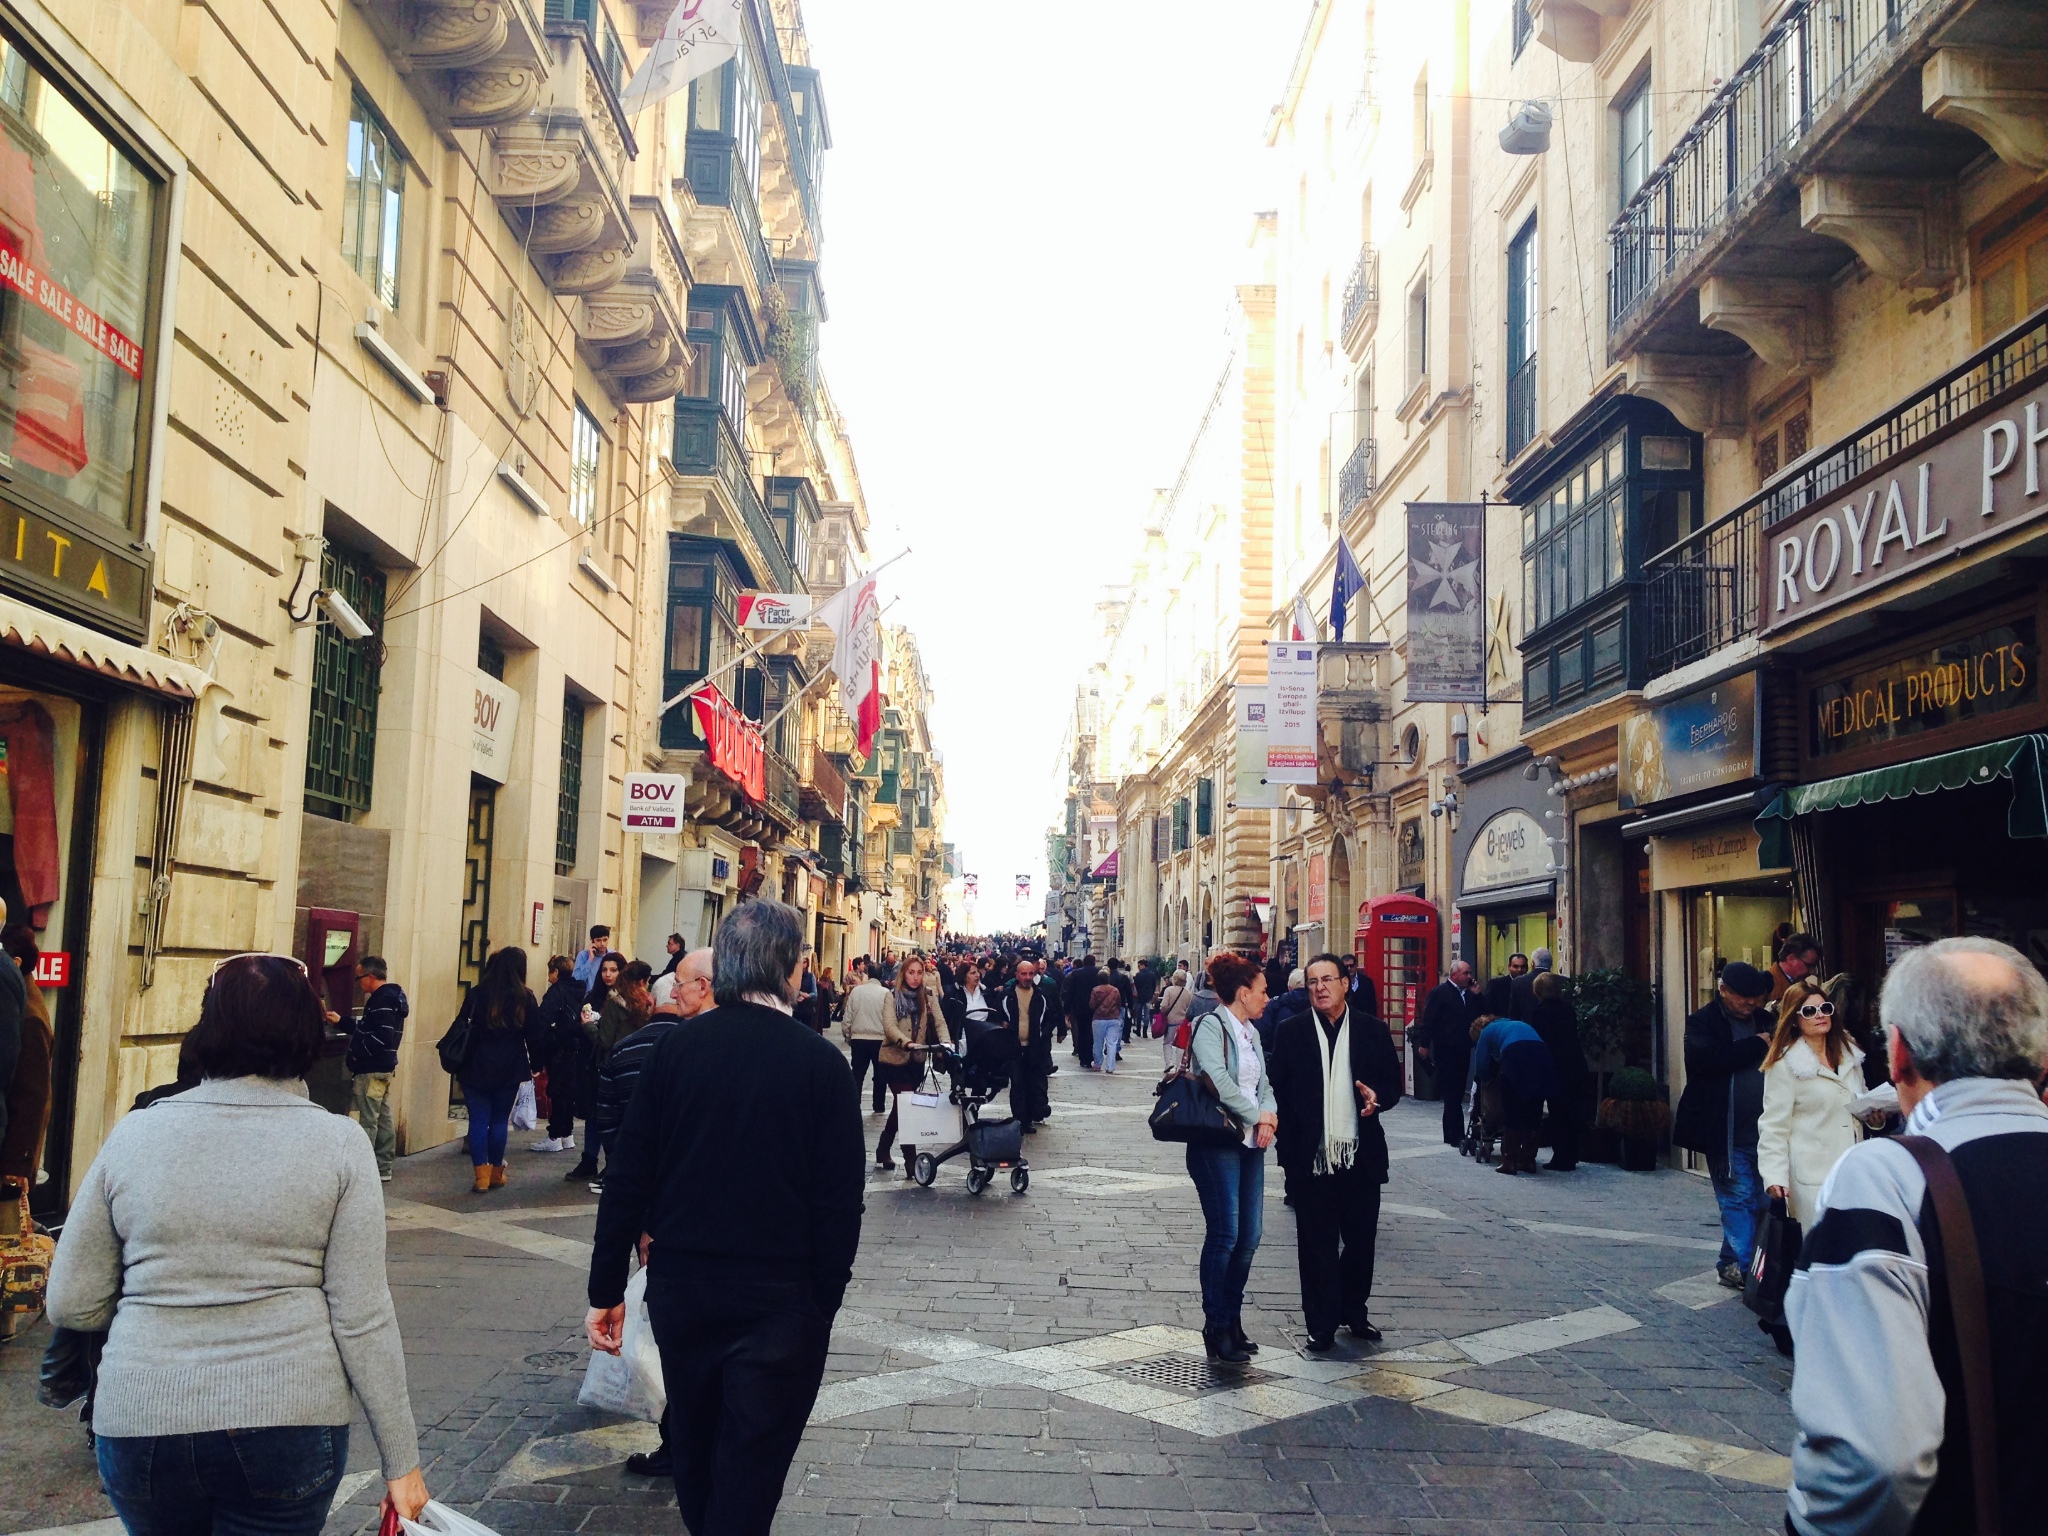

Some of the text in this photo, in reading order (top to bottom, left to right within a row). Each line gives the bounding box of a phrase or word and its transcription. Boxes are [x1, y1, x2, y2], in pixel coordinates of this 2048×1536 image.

[0, 249, 139, 373] SALE SALE SALE SALE
[1421, 523, 1458, 536] STERLING
[1776, 462, 1949, 612] ROYAL
[768, 607, 791, 617] Partit
[1818, 642, 2026, 739] MEDICAL PRODUCTS
[474, 688, 501, 732] BOV
[1680, 773, 1701, 786] TRIBUTE
[1703, 770, 1711, 780] TO
[631, 783, 675, 800] BOV
[640, 817, 663, 826] ATM
[1487, 820, 1525, 861] e-jewels
[1692, 836, 1747, 860] Frank Zampa
